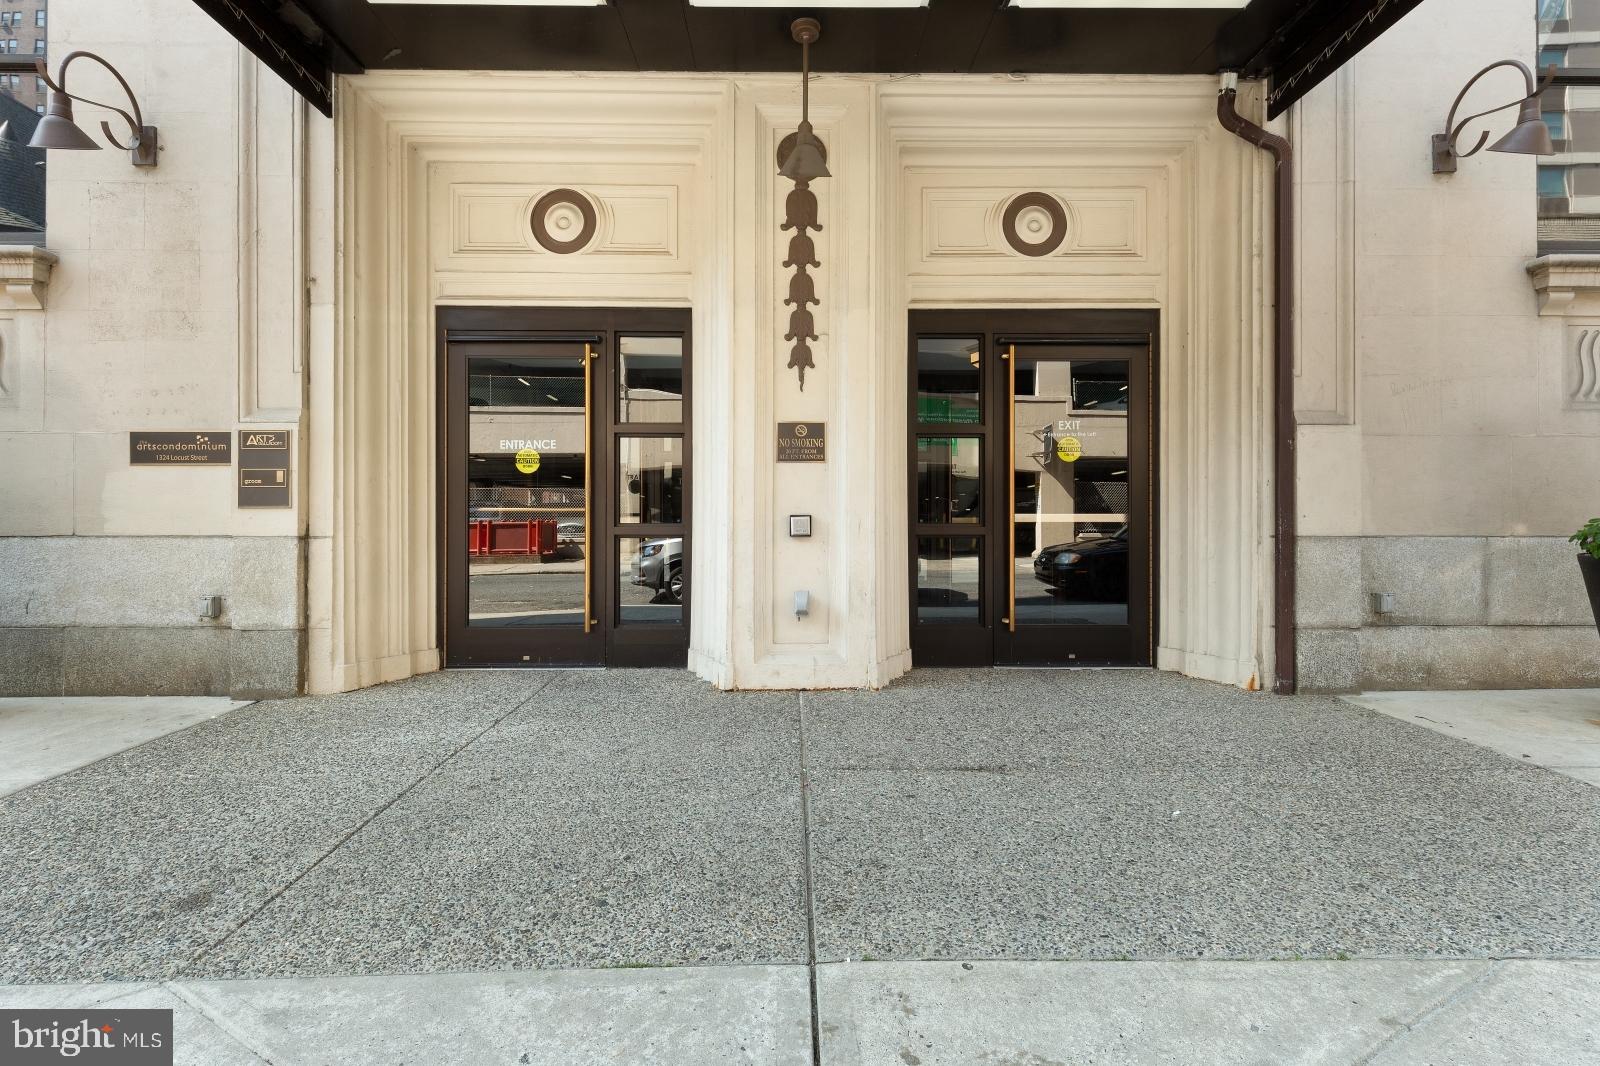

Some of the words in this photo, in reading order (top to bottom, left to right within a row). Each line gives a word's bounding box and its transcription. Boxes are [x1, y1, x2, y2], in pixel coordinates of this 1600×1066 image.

[1058, 420, 1081, 430] EXIT
[136, 441, 227, 451] artscondominium
[500, 439, 557, 450] ENTRANCE
[779, 438, 791, 447] NO
[791, 438, 824, 447] SMOKING
